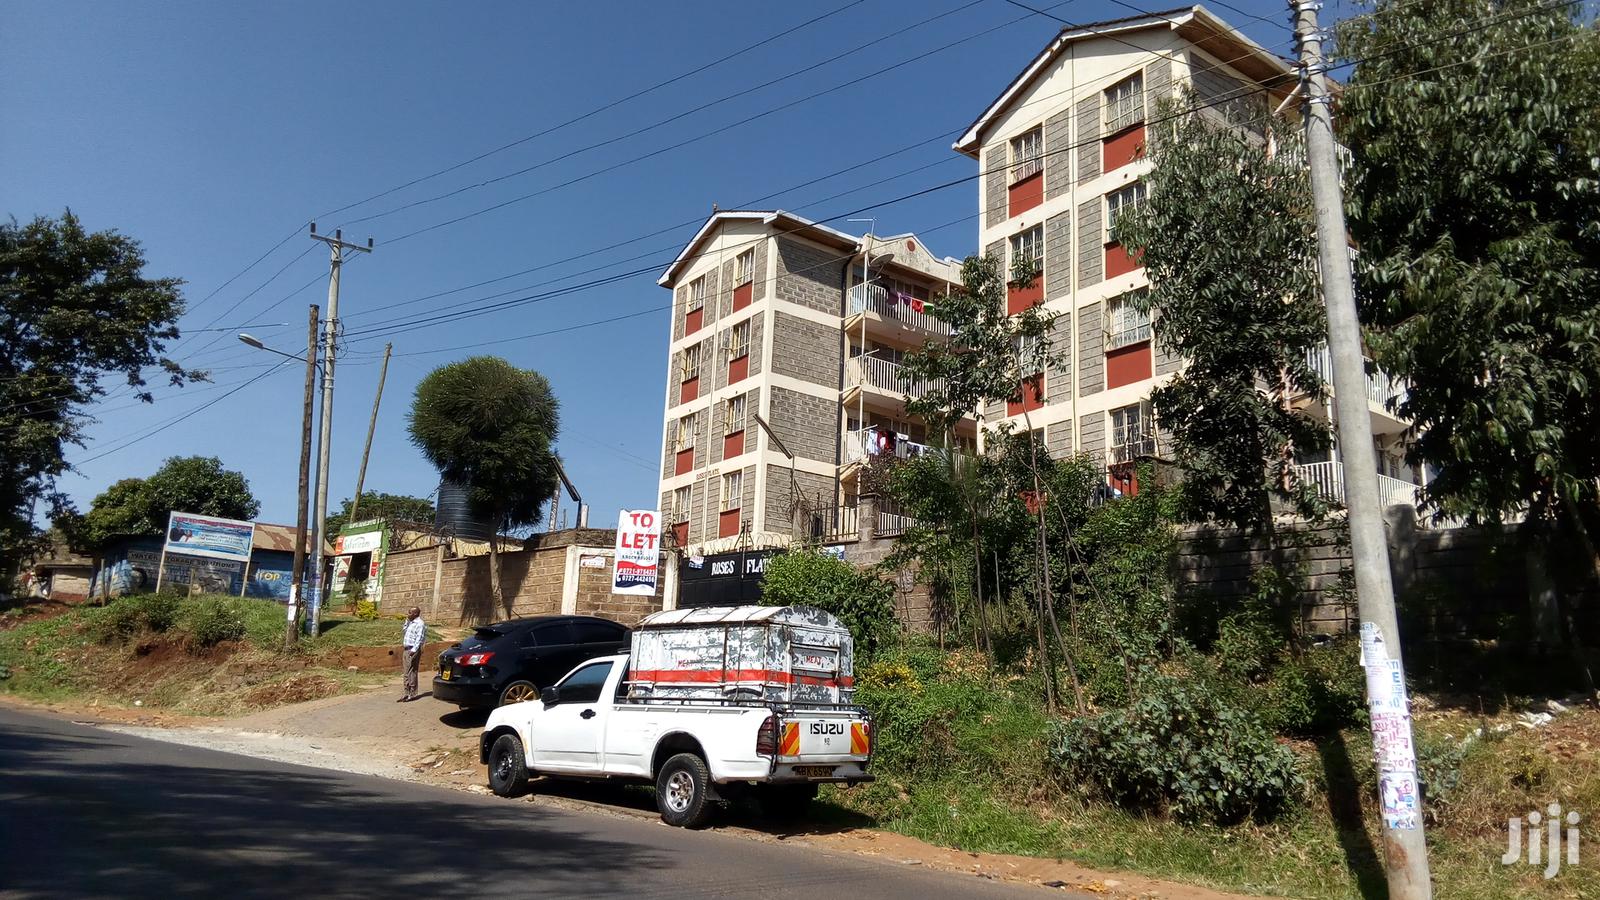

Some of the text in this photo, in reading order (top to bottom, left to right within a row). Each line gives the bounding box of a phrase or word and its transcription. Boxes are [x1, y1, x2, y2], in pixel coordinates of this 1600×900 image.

[630, 513, 654, 528] TO
[621, 532, 658, 549] LET
[164, 555, 192, 566] TORAGE
[711, 560, 736, 576] ROSES
[810, 723, 844, 735] ISUZU
